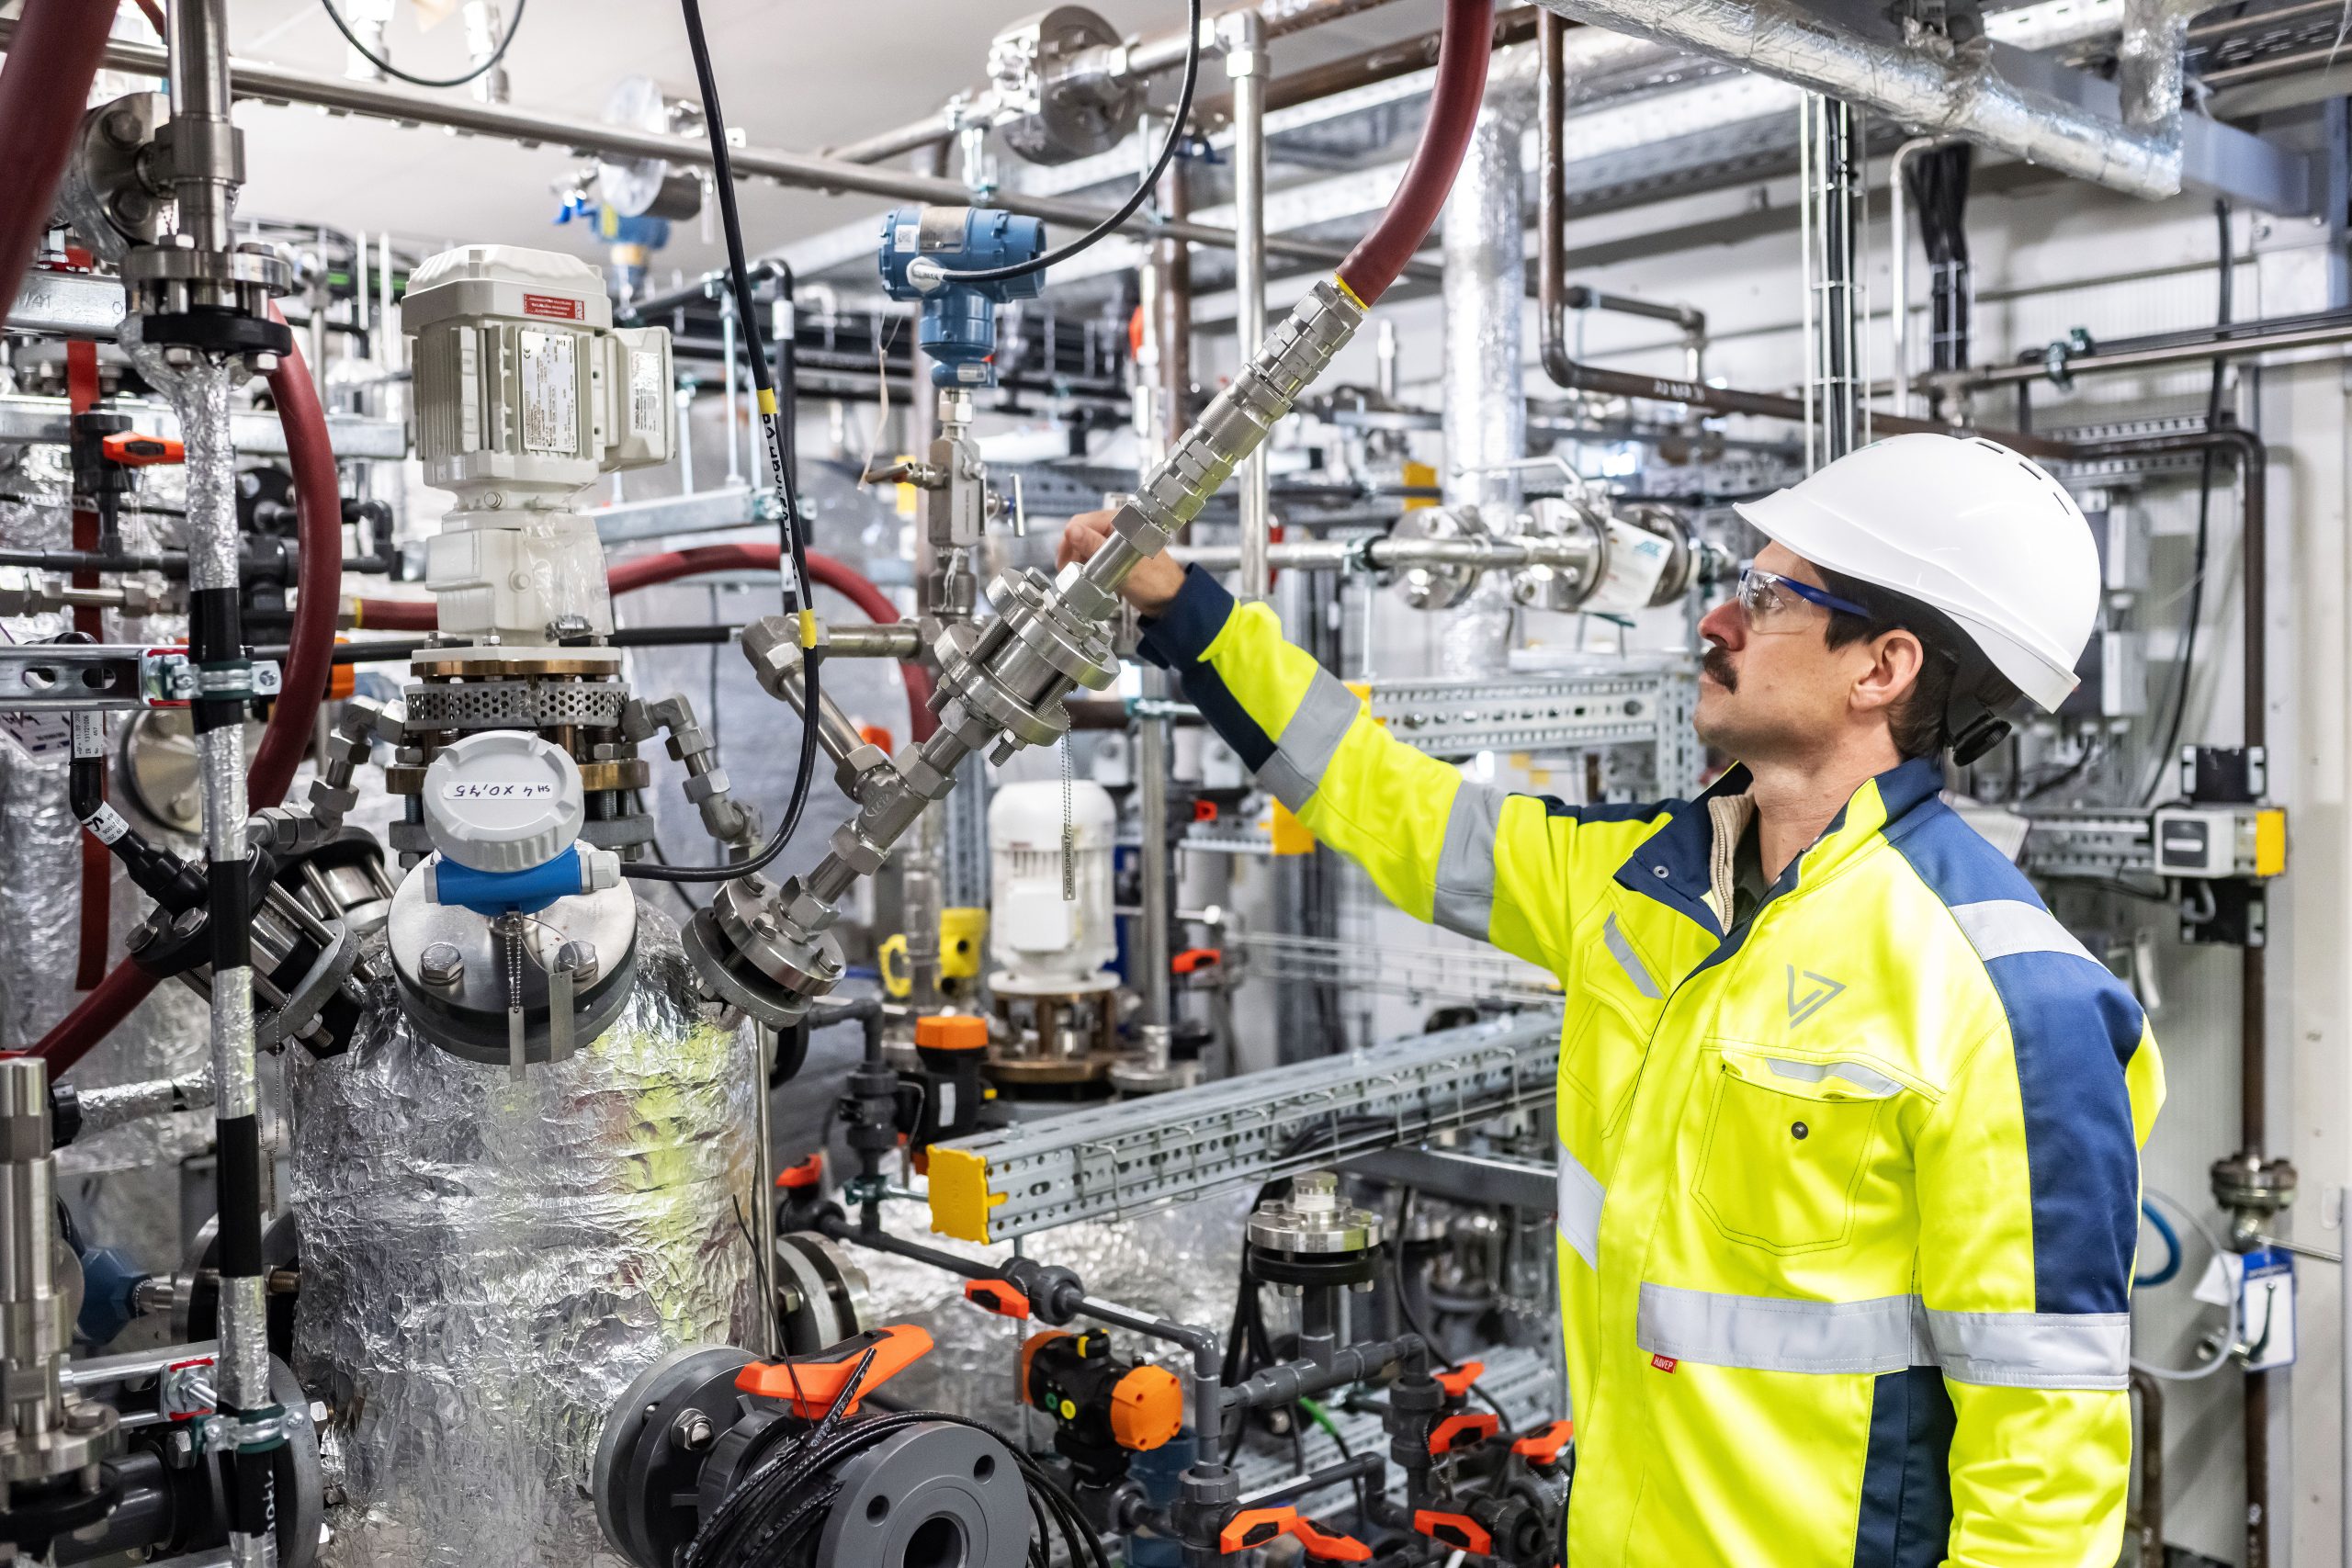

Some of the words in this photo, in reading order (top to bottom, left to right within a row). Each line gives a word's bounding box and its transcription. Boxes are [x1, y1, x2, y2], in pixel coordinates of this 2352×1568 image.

[523, 786, 533, 797] 4
[537, 784, 550, 793] SH
[1653, 1356, 1674, 1370] HAVEP
